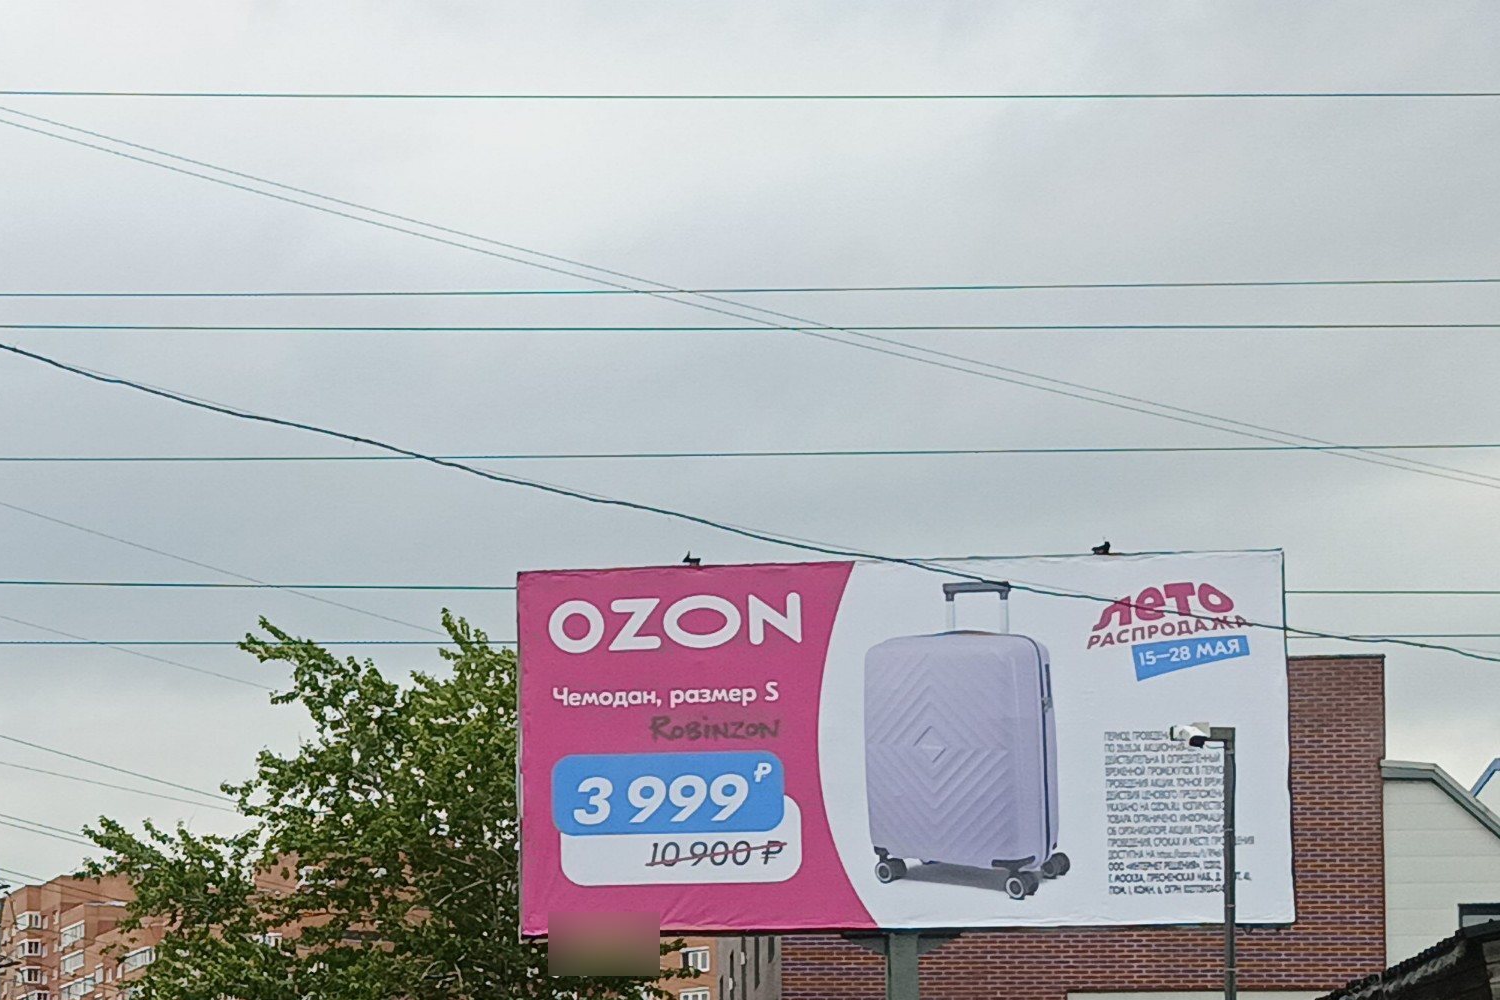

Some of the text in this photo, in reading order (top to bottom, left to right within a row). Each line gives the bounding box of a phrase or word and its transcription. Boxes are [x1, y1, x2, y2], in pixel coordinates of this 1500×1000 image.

[548, 592, 802, 654] OZON
[1087, 615, 1251, 649] РАСПРОДАЖА
[1196, 638, 1241, 659] МАЯ
[552, 682, 779, 709] Чемодан, размер S
[573, 776, 613, 826] 3
[628, 774, 749, 825] 999
[650, 843, 680, 867] 10
[690, 841, 752, 867] 900
